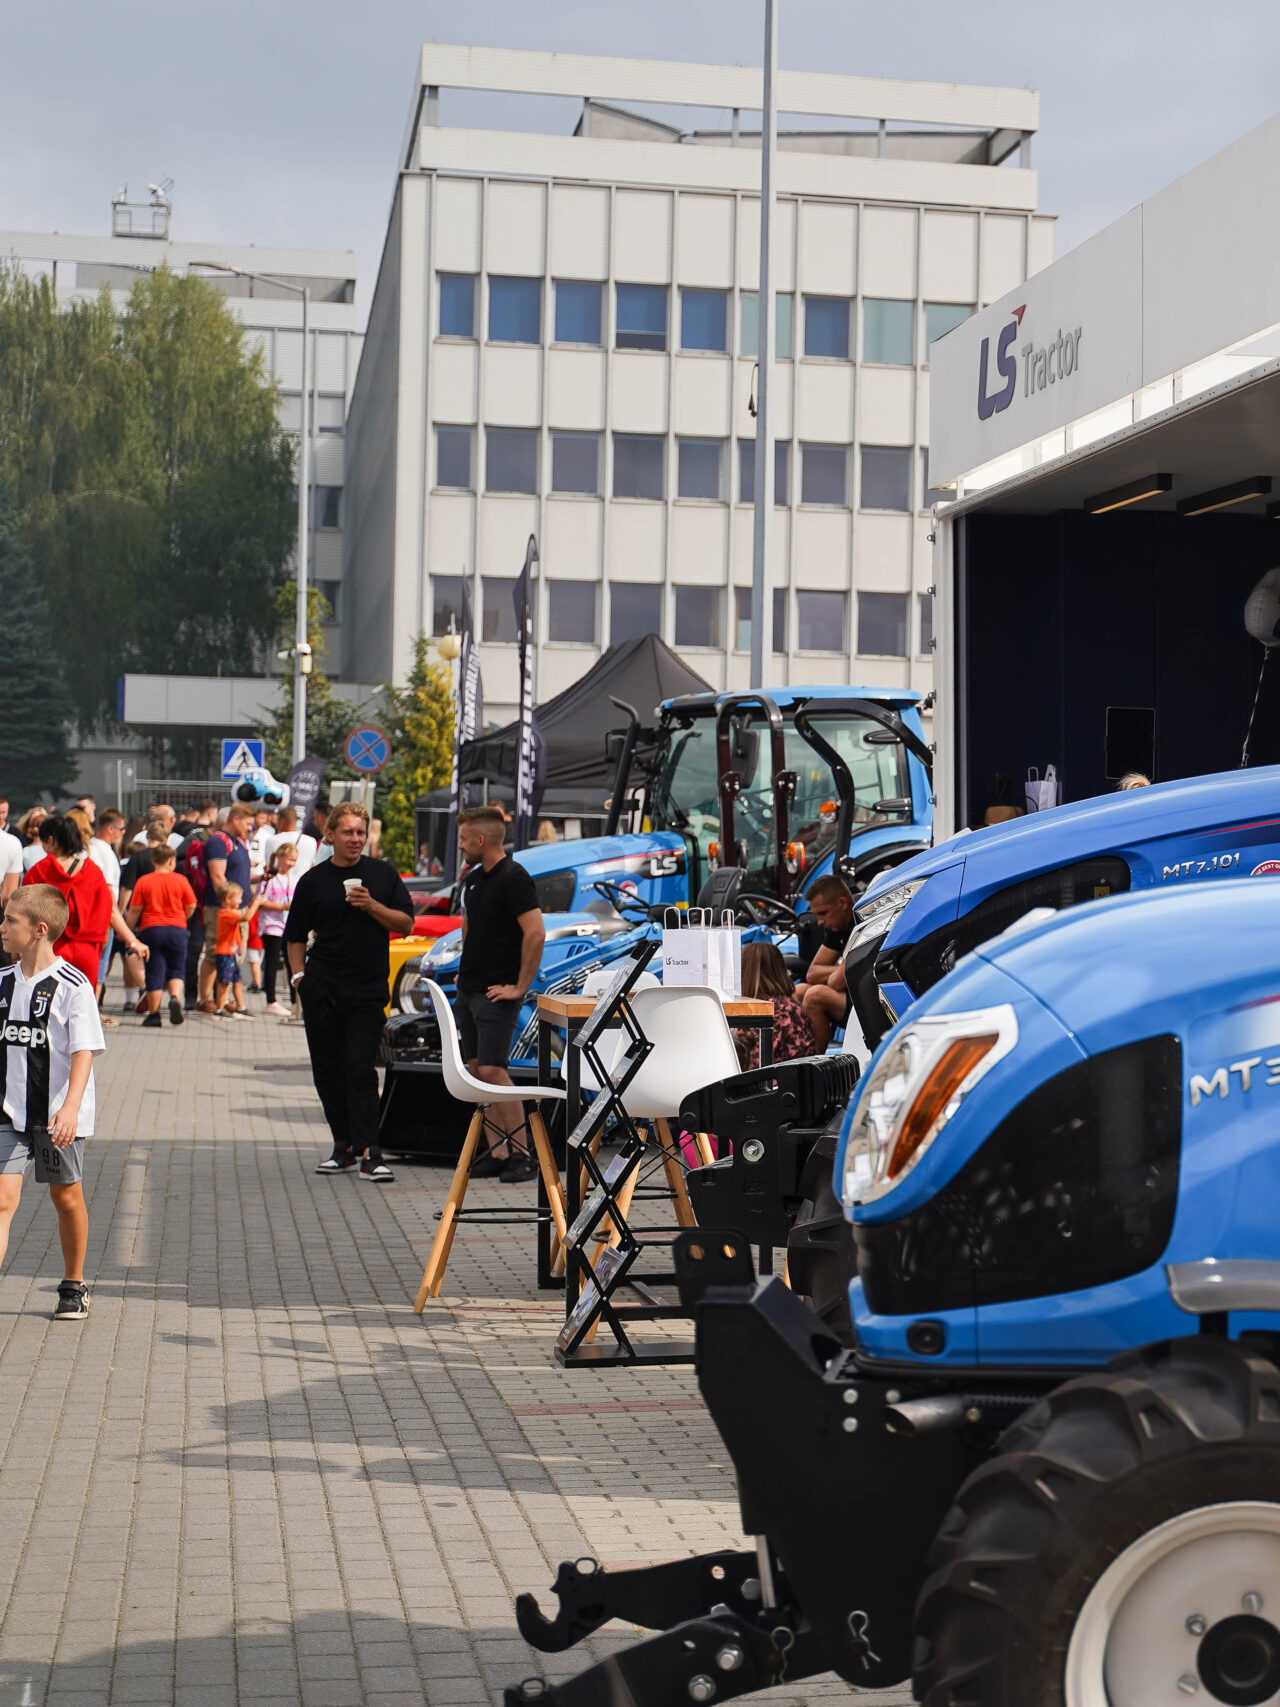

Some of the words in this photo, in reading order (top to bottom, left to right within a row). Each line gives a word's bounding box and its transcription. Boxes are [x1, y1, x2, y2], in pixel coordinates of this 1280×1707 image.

[977, 320, 1018, 421] LS
[1022, 326, 1082, 398] Tractor
[650, 856, 678, 877] LS
[1163, 852, 1240, 880] MT7.101
[1261, 863, 1275, 872] BEST
[0, 1019, 46, 1048] Jeep
